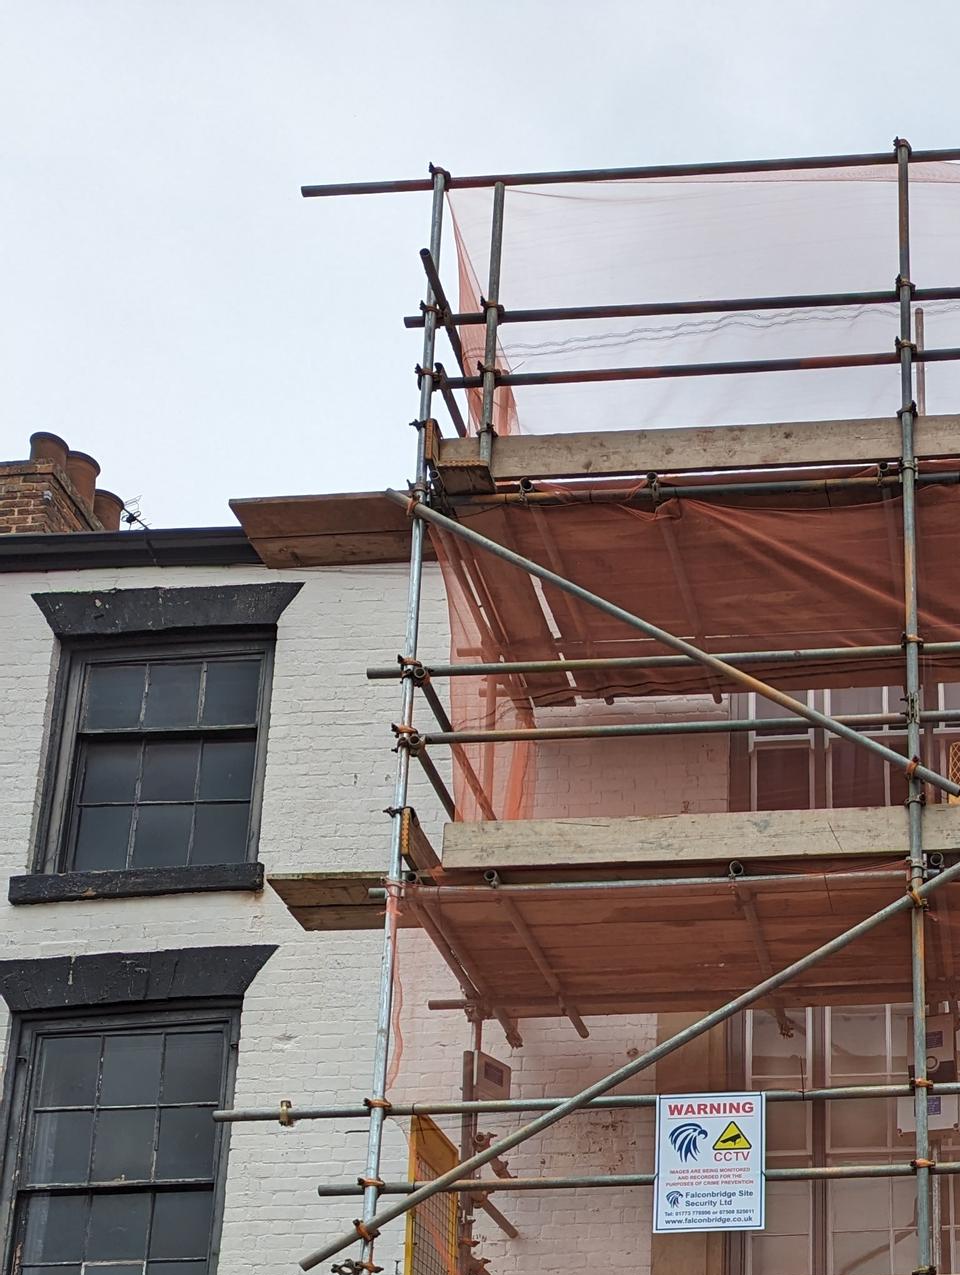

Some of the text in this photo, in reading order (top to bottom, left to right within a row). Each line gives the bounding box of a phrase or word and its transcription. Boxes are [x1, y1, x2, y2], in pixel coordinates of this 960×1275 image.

[668, 1102, 754, 1116] WARNING
[714, 1151, 750, 1162] CCTV
[685, 1190, 736, 1199] Falconbridge
[685, 1200, 717, 1208] Security
[665, 1216, 752, 1225] www.falconbridge.co.uk
